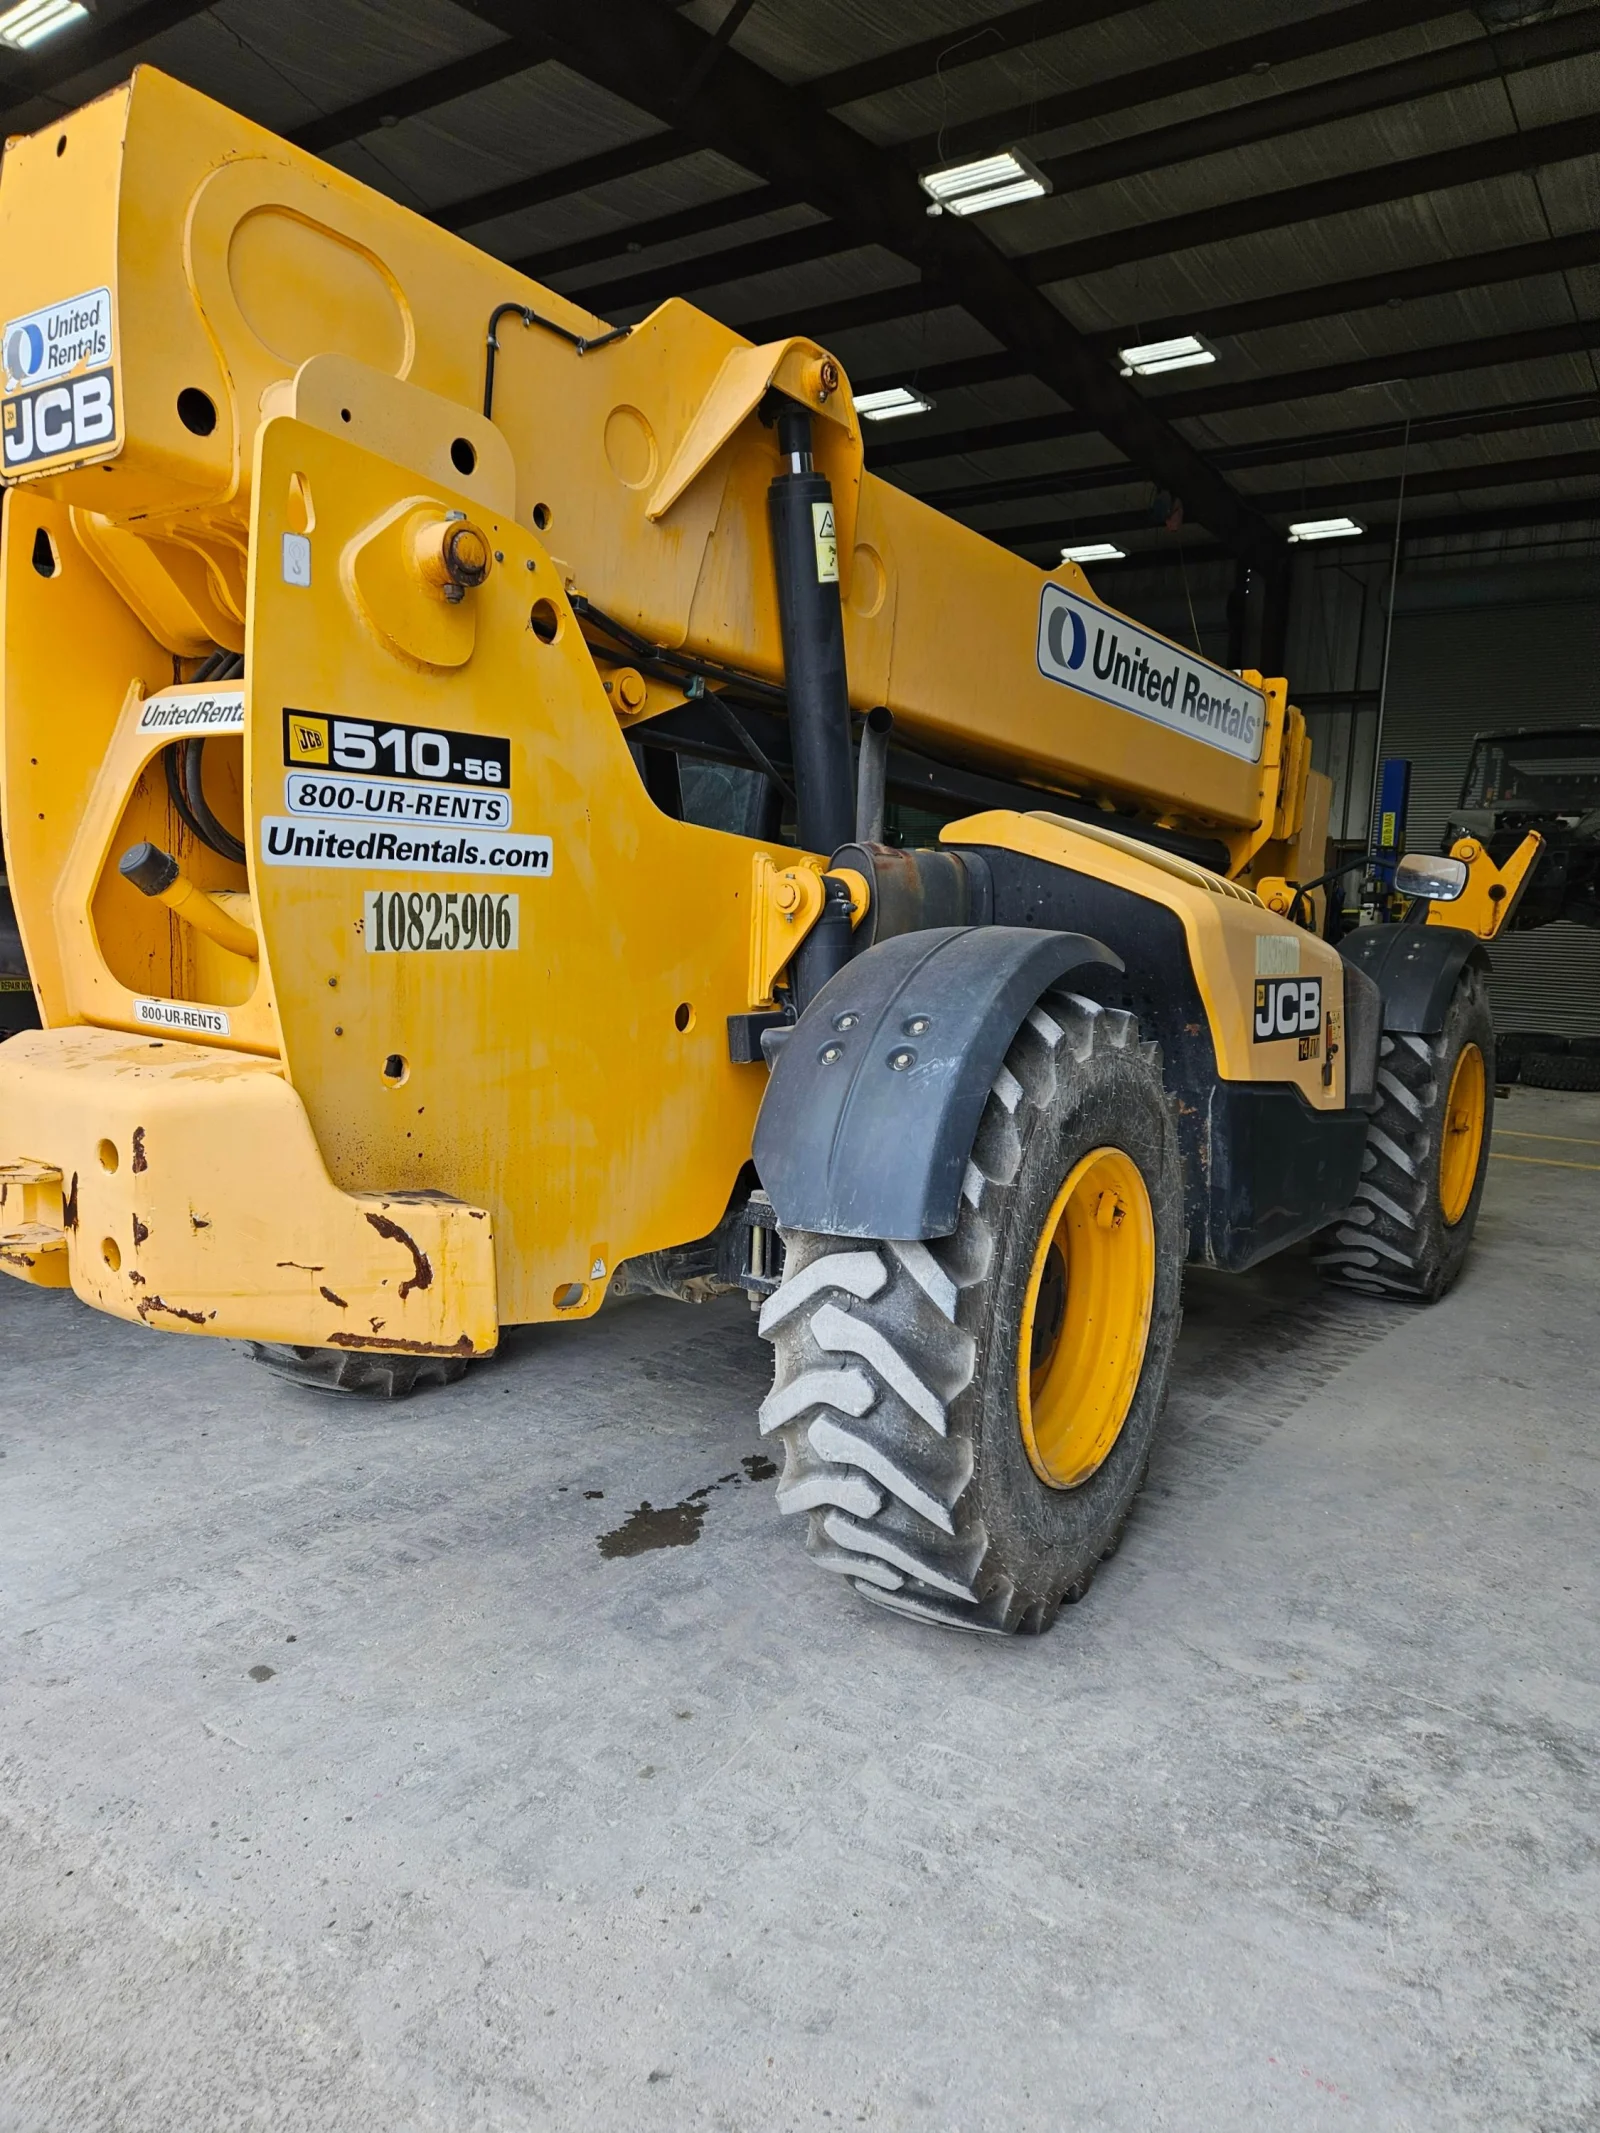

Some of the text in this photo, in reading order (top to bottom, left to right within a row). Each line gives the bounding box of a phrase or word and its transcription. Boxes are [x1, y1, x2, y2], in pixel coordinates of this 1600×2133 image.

[47, 300, 101, 341] United
[48, 330, 106, 369] Rentals
[5, 376, 114, 462] JCB
[1092, 628, 1257, 744] United Rentals
[299, 728, 322, 750] JCB
[298, 783, 502, 821] 800-UR-RENTS
[267, 826, 550, 868] UnitedRentals.com
[372, 891, 512, 952] 10825906
[141, 1005, 222, 1030] 800-UR-RENTS
[1256, 982, 1320, 1037] JCB
